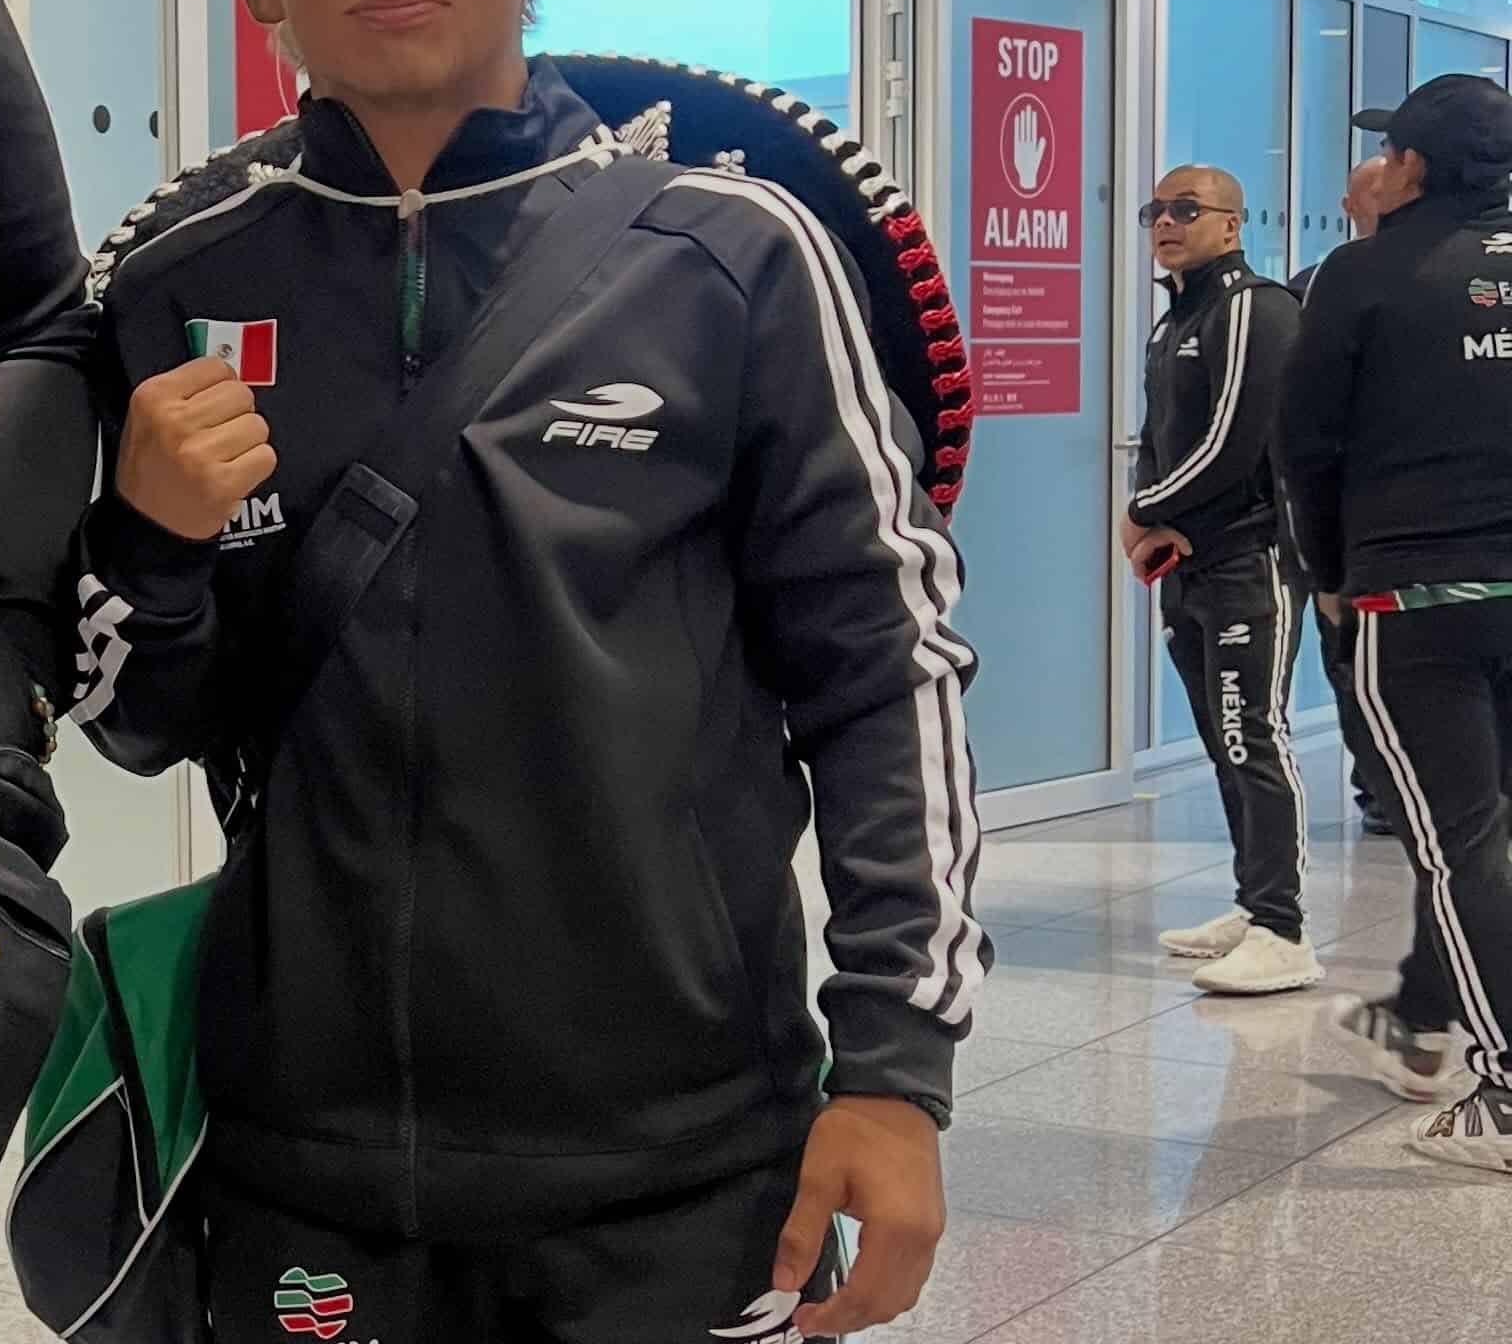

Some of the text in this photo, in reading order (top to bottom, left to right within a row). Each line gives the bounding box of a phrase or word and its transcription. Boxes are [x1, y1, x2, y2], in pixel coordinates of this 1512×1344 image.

[997, 36, 1059, 82] STOP
[984, 207, 1069, 250] ALARM
[542, 420, 659, 451] FIRE
[223, 492, 284, 533] MM
[1220, 670, 1248, 765] MÉXICO
